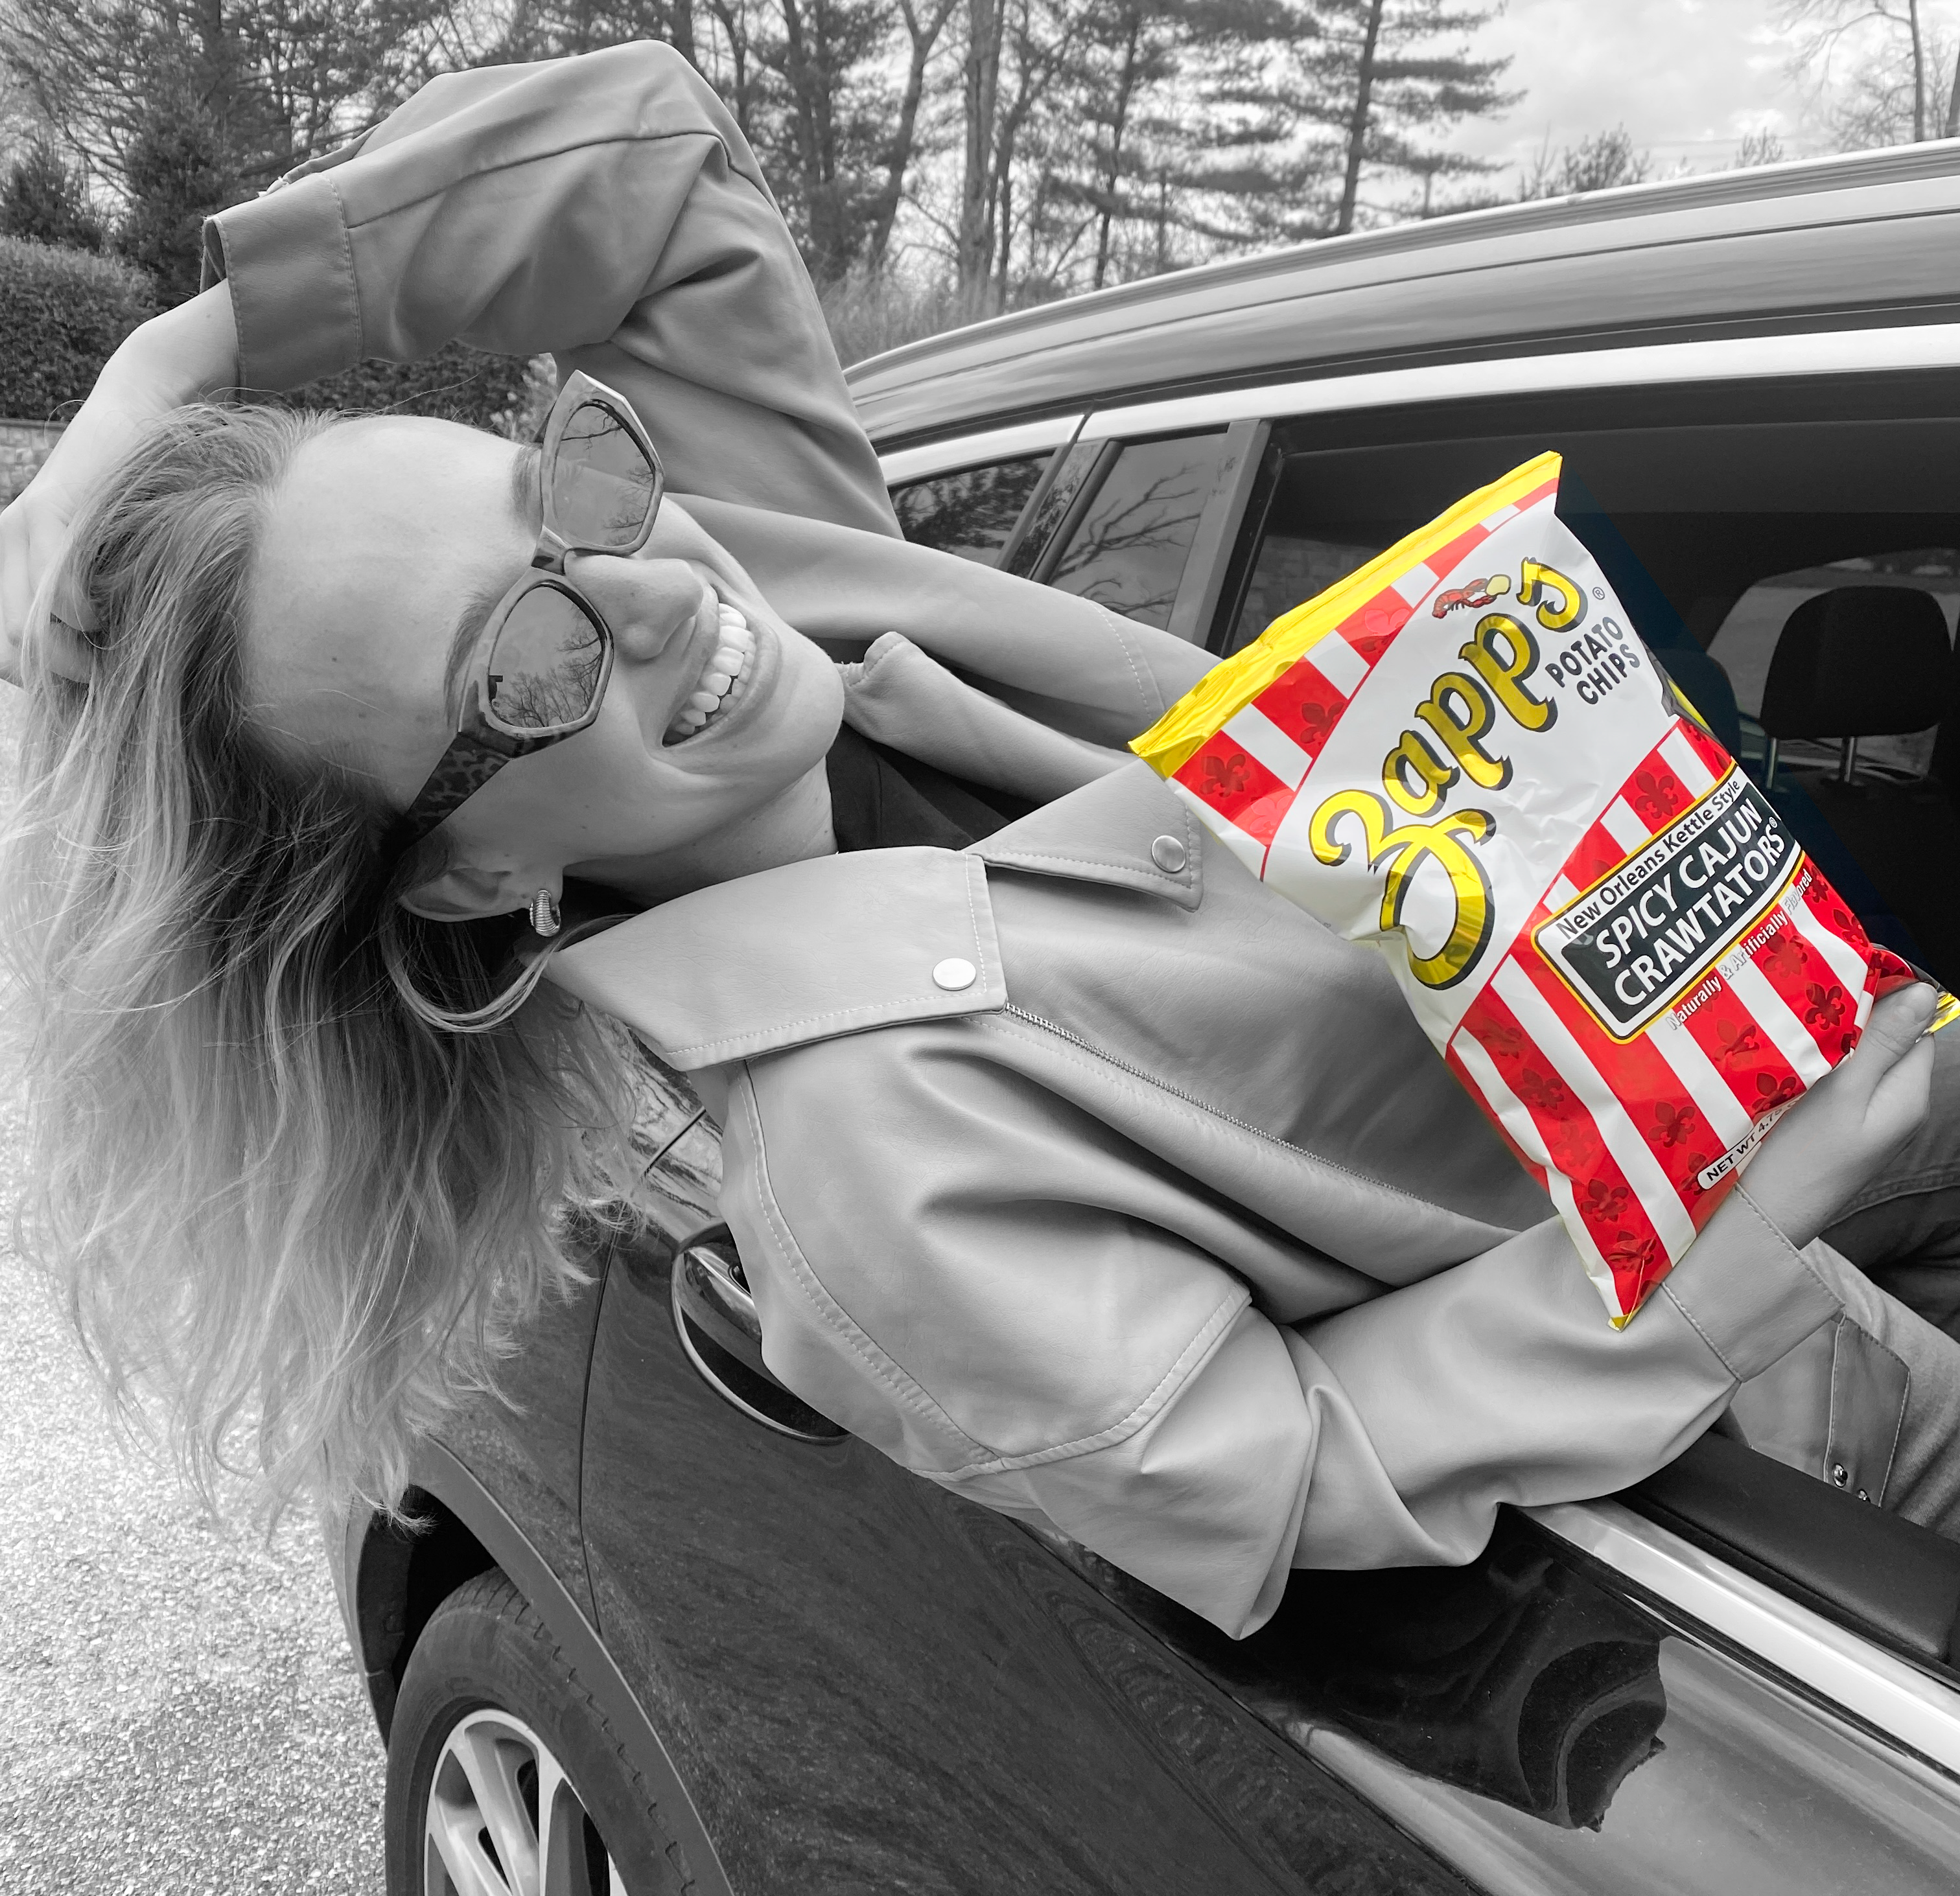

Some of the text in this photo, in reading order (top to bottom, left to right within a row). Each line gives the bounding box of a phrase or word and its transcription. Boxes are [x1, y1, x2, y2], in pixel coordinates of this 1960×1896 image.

[1545, 617, 1623, 688] POTATO
[1577, 644, 1640, 704] CHIPS
[1556, 780, 1740, 940] New Orleans Kettle Style
[1596, 798, 1762, 968] SPICY CAJUN
[1665, 868, 1813, 1030] Naturally & Artificially Flavored
[1707, 1154, 1734, 1181] NET
[1736, 1132, 1755, 1155] WT
